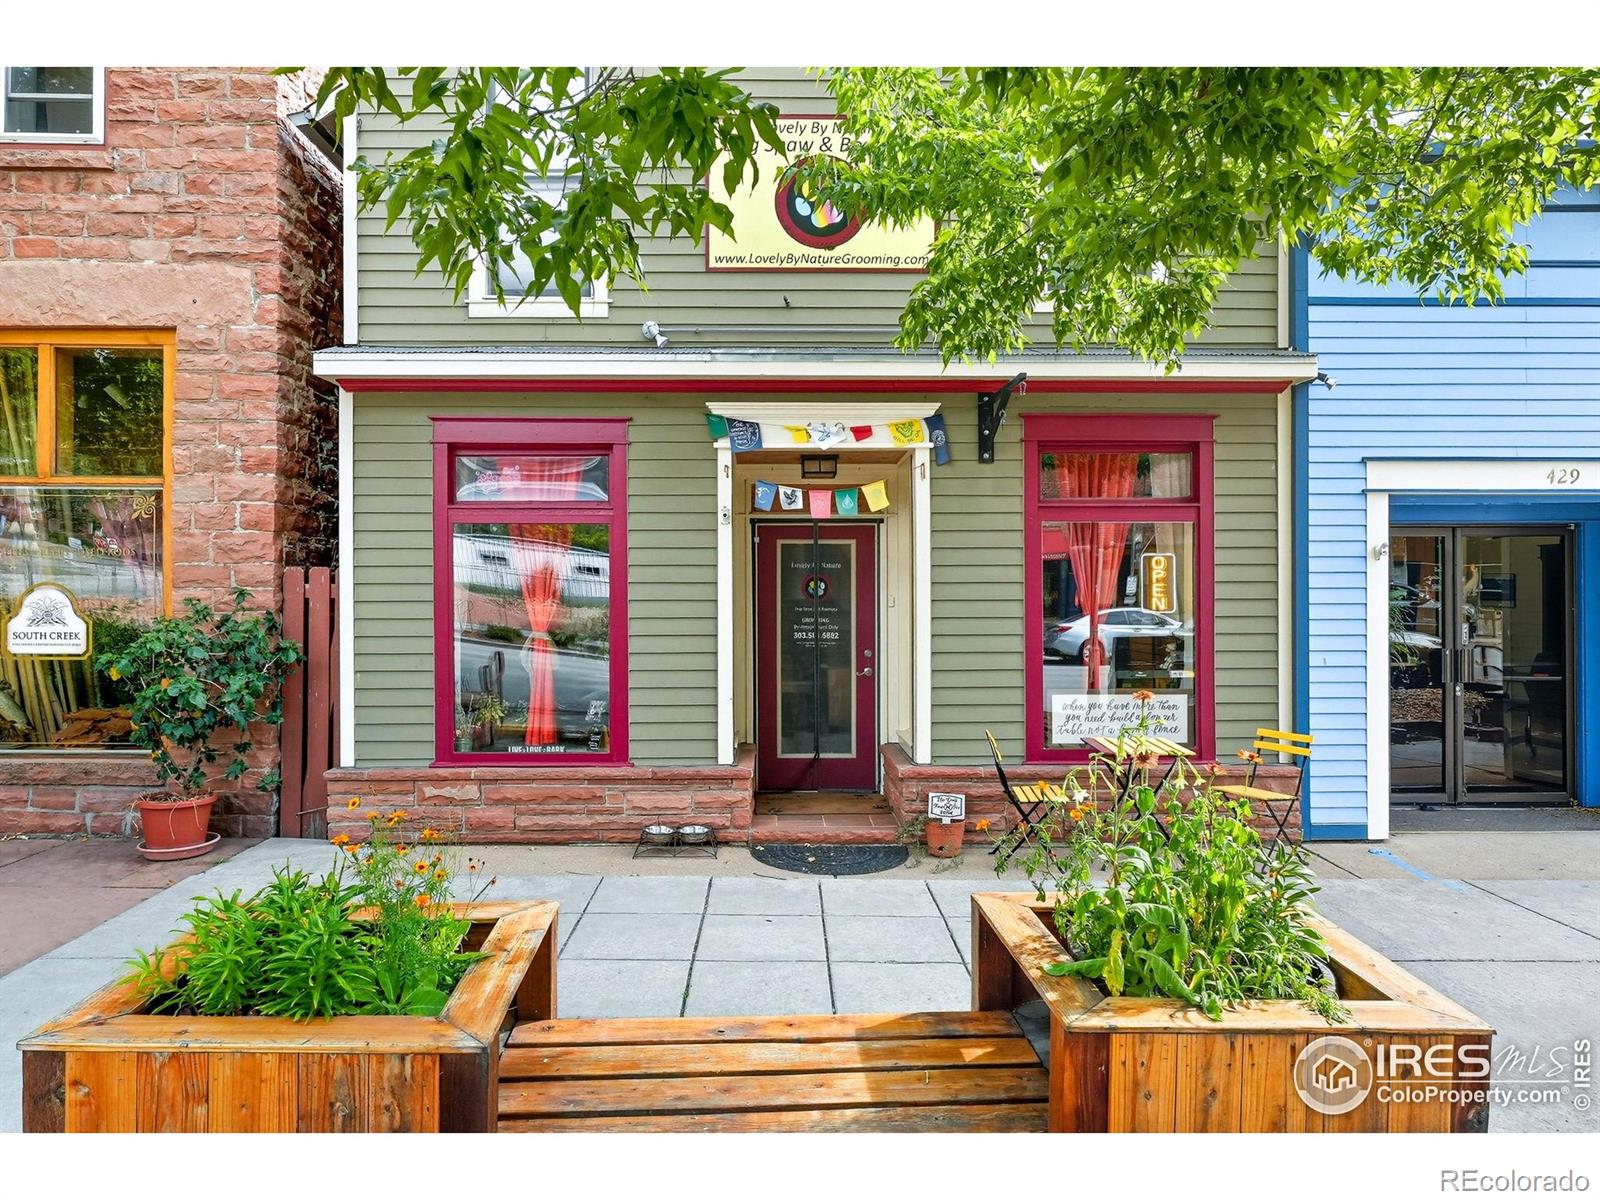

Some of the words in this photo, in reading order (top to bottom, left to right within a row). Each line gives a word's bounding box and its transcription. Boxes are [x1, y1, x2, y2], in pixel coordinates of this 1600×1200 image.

[811, 121, 828, 136] By
[819, 136, 833, 152] &
[714, 253, 929, 267] www.LovelyByNatureGrooming.com
[1546, 468, 1580, 484] 429
[1151, 556, 1168, 611] OPEN
[12, 631, 47, 640] SOUTH
[49, 631, 81, 640] CREEK
[1086, 701, 1102, 715] you
[1106, 699, 1130, 711] have
[1156, 700, 1180, 711] than
[1064, 713, 1082, 726] you
[1084, 712, 1105, 723] need
[1108, 712, 1135, 723] build
[1056, 724, 1086, 735] table
[1087, 725, 1109, 735] not
